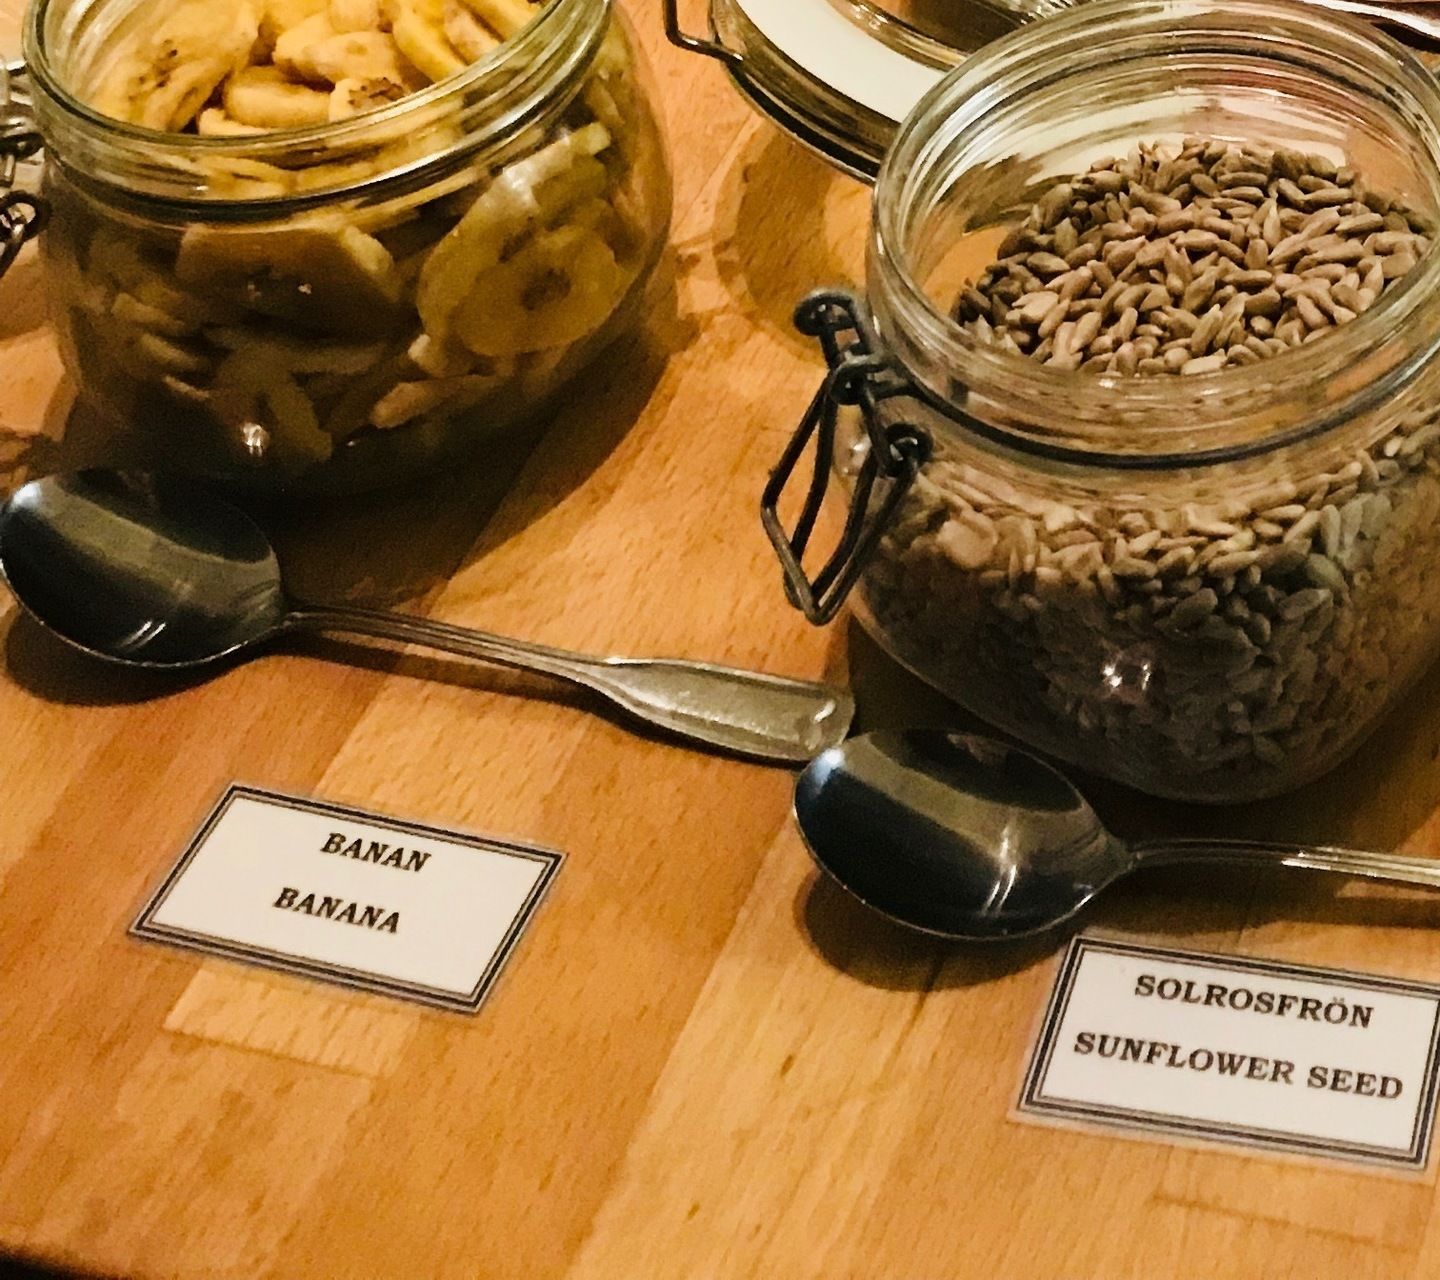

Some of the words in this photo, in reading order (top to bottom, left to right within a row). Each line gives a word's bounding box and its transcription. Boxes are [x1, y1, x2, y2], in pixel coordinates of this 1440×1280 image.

[319, 831, 432, 874] BANAN
[272, 886, 401, 935] BANANA
[1134, 974, 1375, 1030] SOLROSFRÖN
[1073, 1031, 1296, 1085] SUNFLOWER
[1306, 1065, 1404, 1101] SEED
